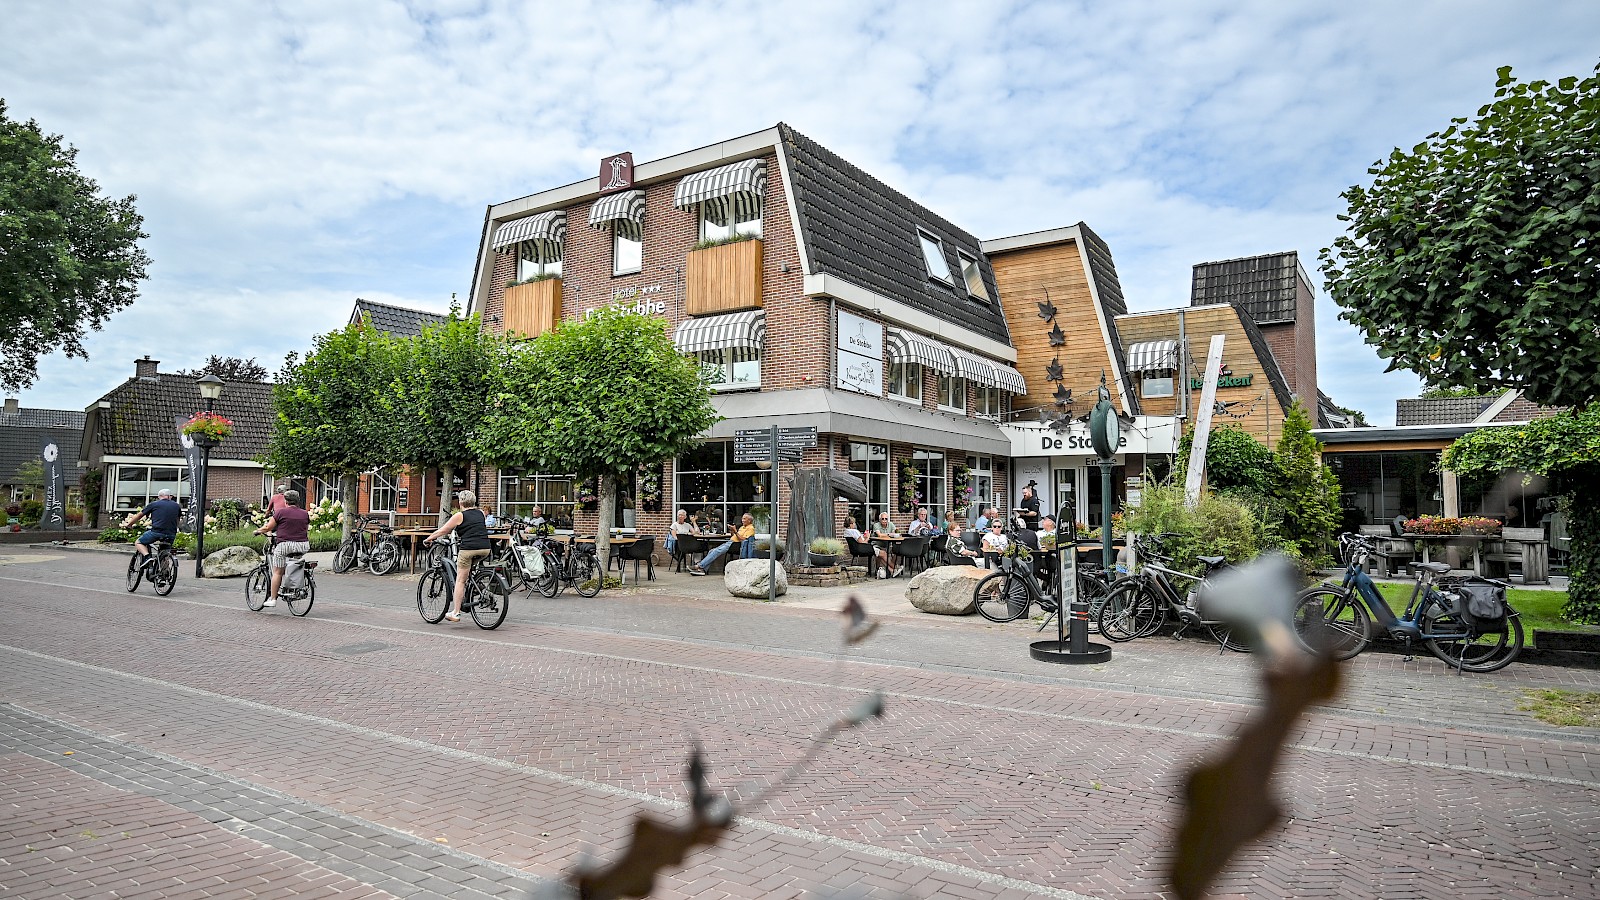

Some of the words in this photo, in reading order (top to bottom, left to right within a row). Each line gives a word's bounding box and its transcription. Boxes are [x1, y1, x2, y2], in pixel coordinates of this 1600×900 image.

[611, 284, 637, 300] Hotel
[849, 336, 855, 344] De
[857, 338, 872, 350] Stobbe
[1041, 436, 1063, 450] De
[1068, 435, 1127, 449] Stoe
